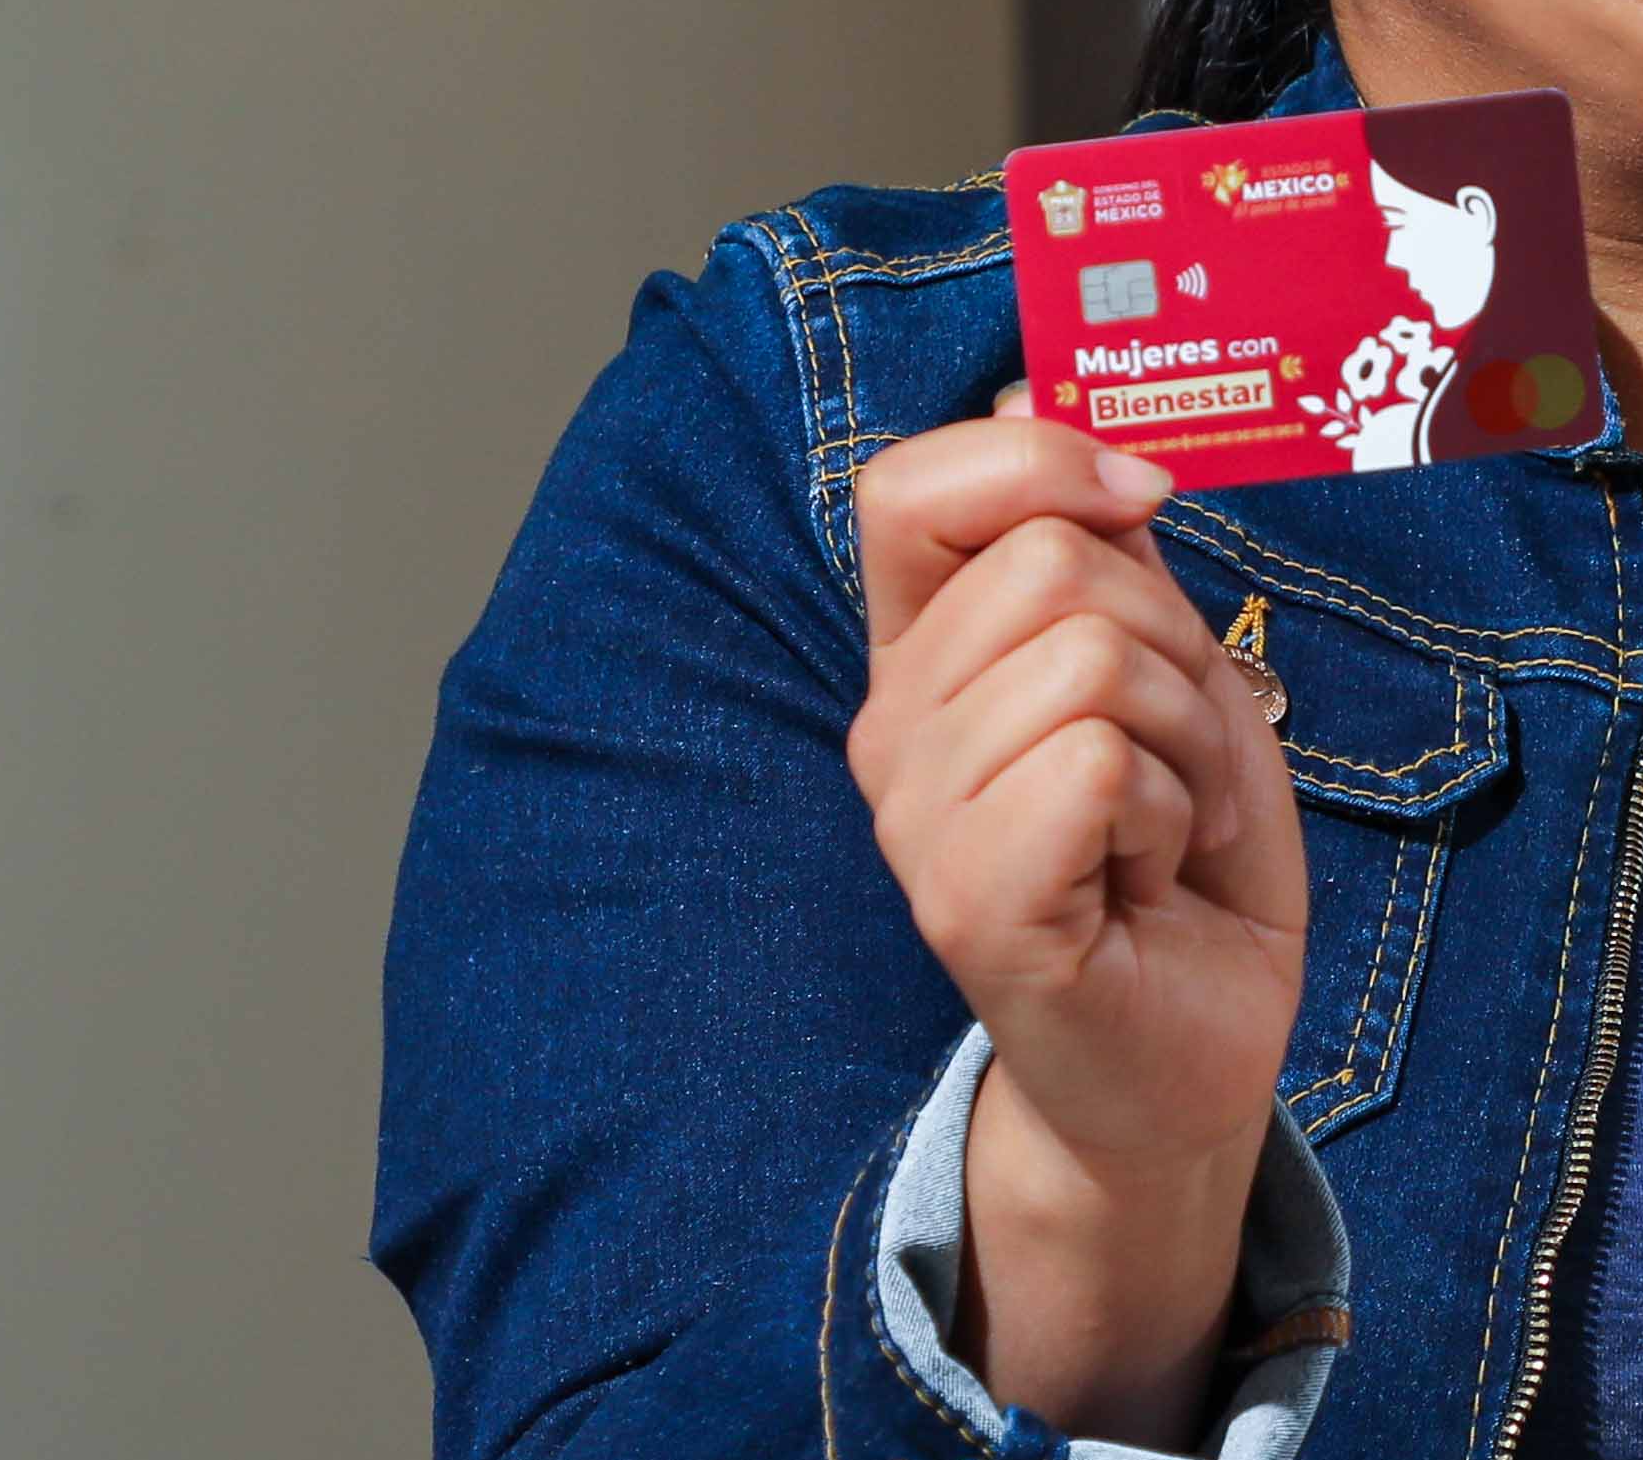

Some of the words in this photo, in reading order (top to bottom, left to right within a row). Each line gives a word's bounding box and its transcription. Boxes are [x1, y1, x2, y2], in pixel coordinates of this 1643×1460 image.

[1075, 339, 1219, 377] Mujeres
[1227, 337, 1278, 358] con
[1096, 381, 1266, 421] Bienestar
